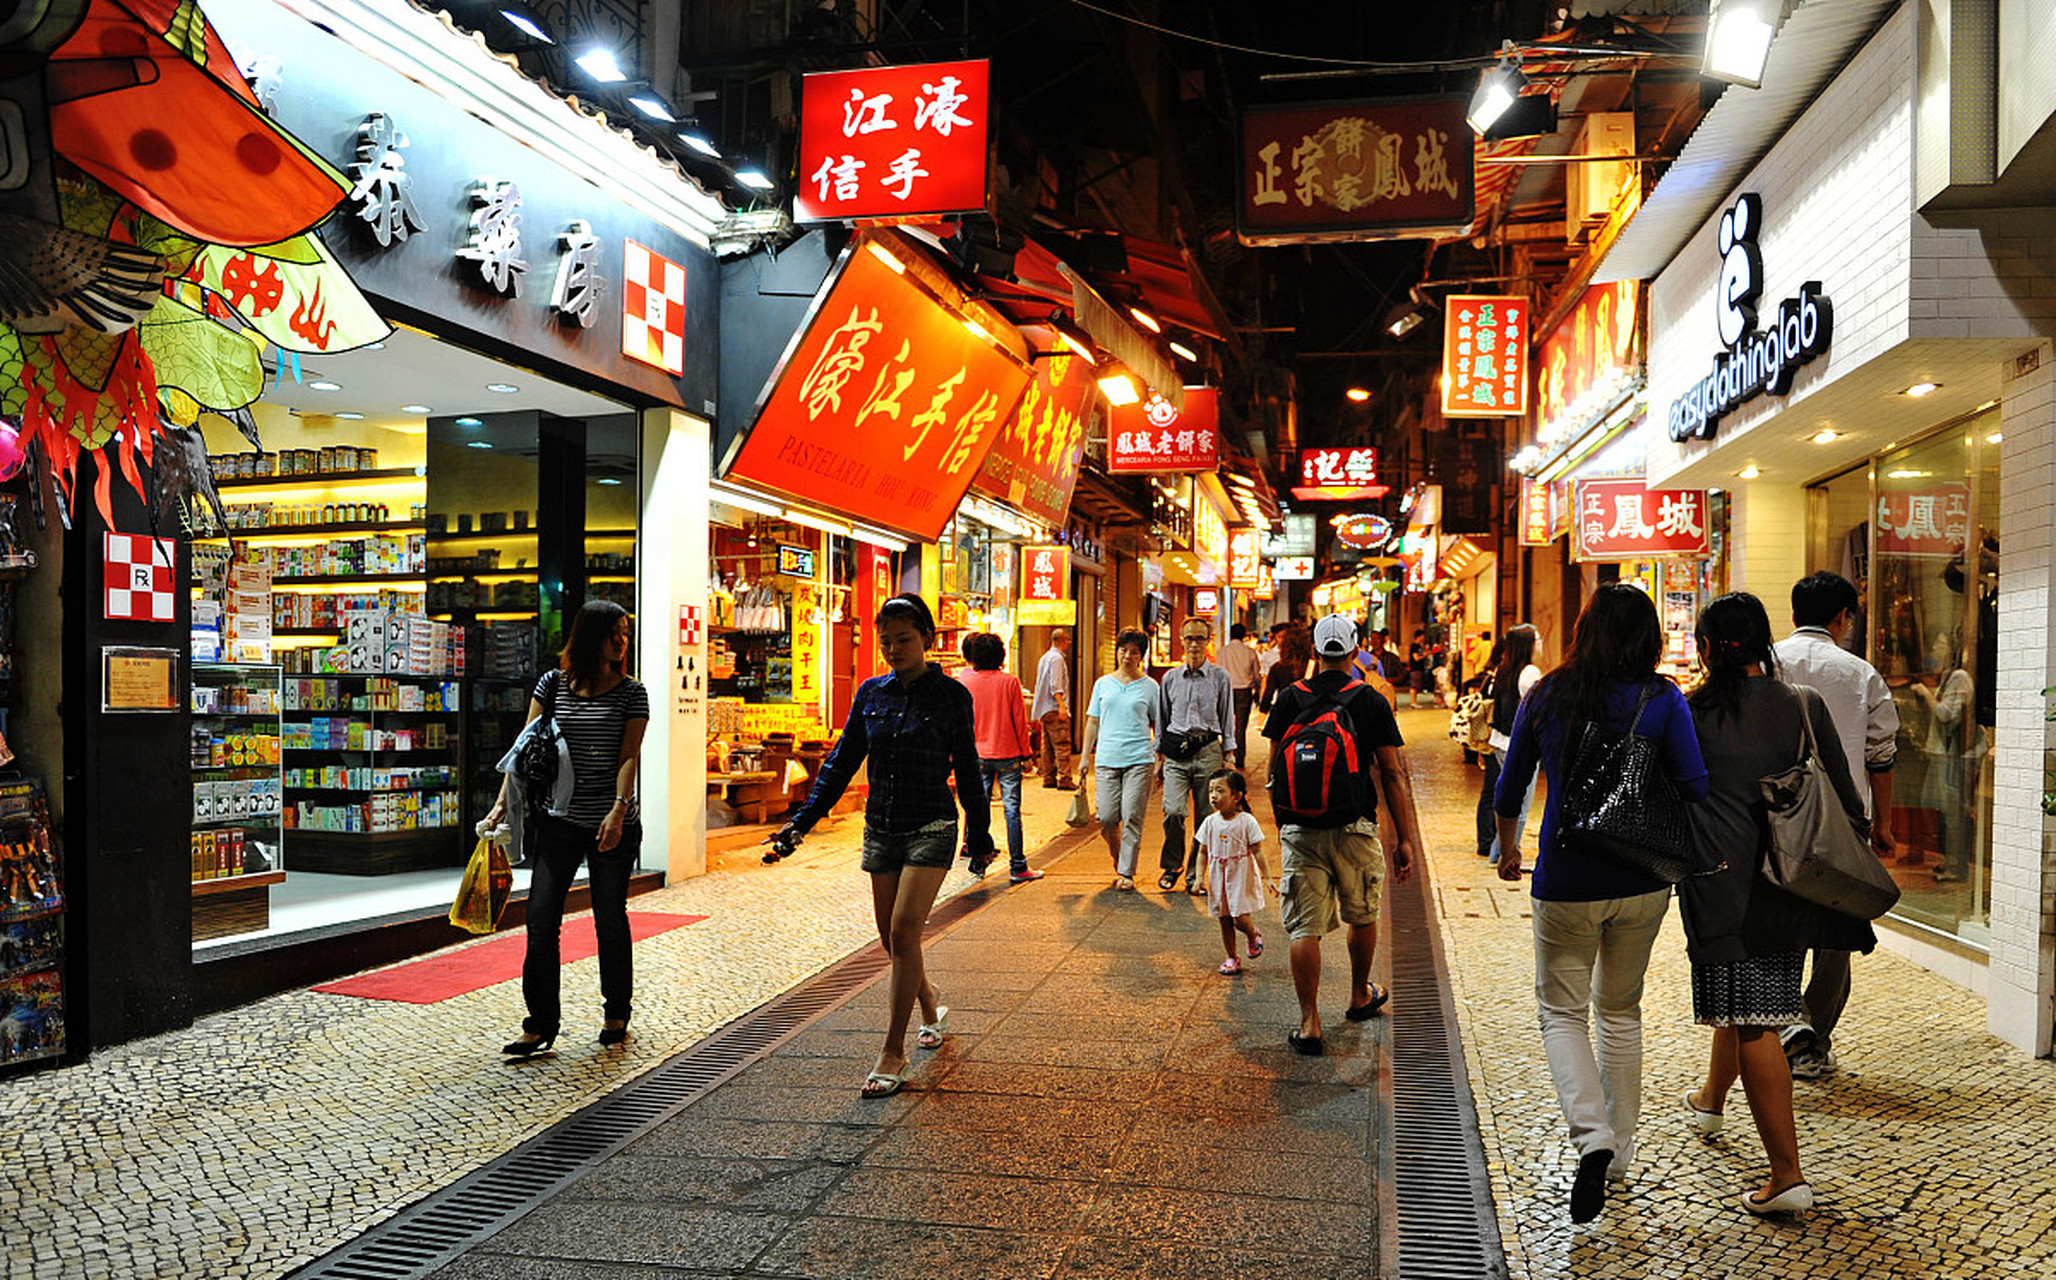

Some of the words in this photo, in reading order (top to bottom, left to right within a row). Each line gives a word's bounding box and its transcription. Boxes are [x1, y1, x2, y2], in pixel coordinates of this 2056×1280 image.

[1472, 303, 1498, 407] 正宗鳳城
[1115, 429, 1214, 455] 鳳城老餅家
[1584, 493, 1606, 545] 正宗
[1607, 491, 1703, 540] 鳳城
[1032, 551, 1057, 600] 鳳城
